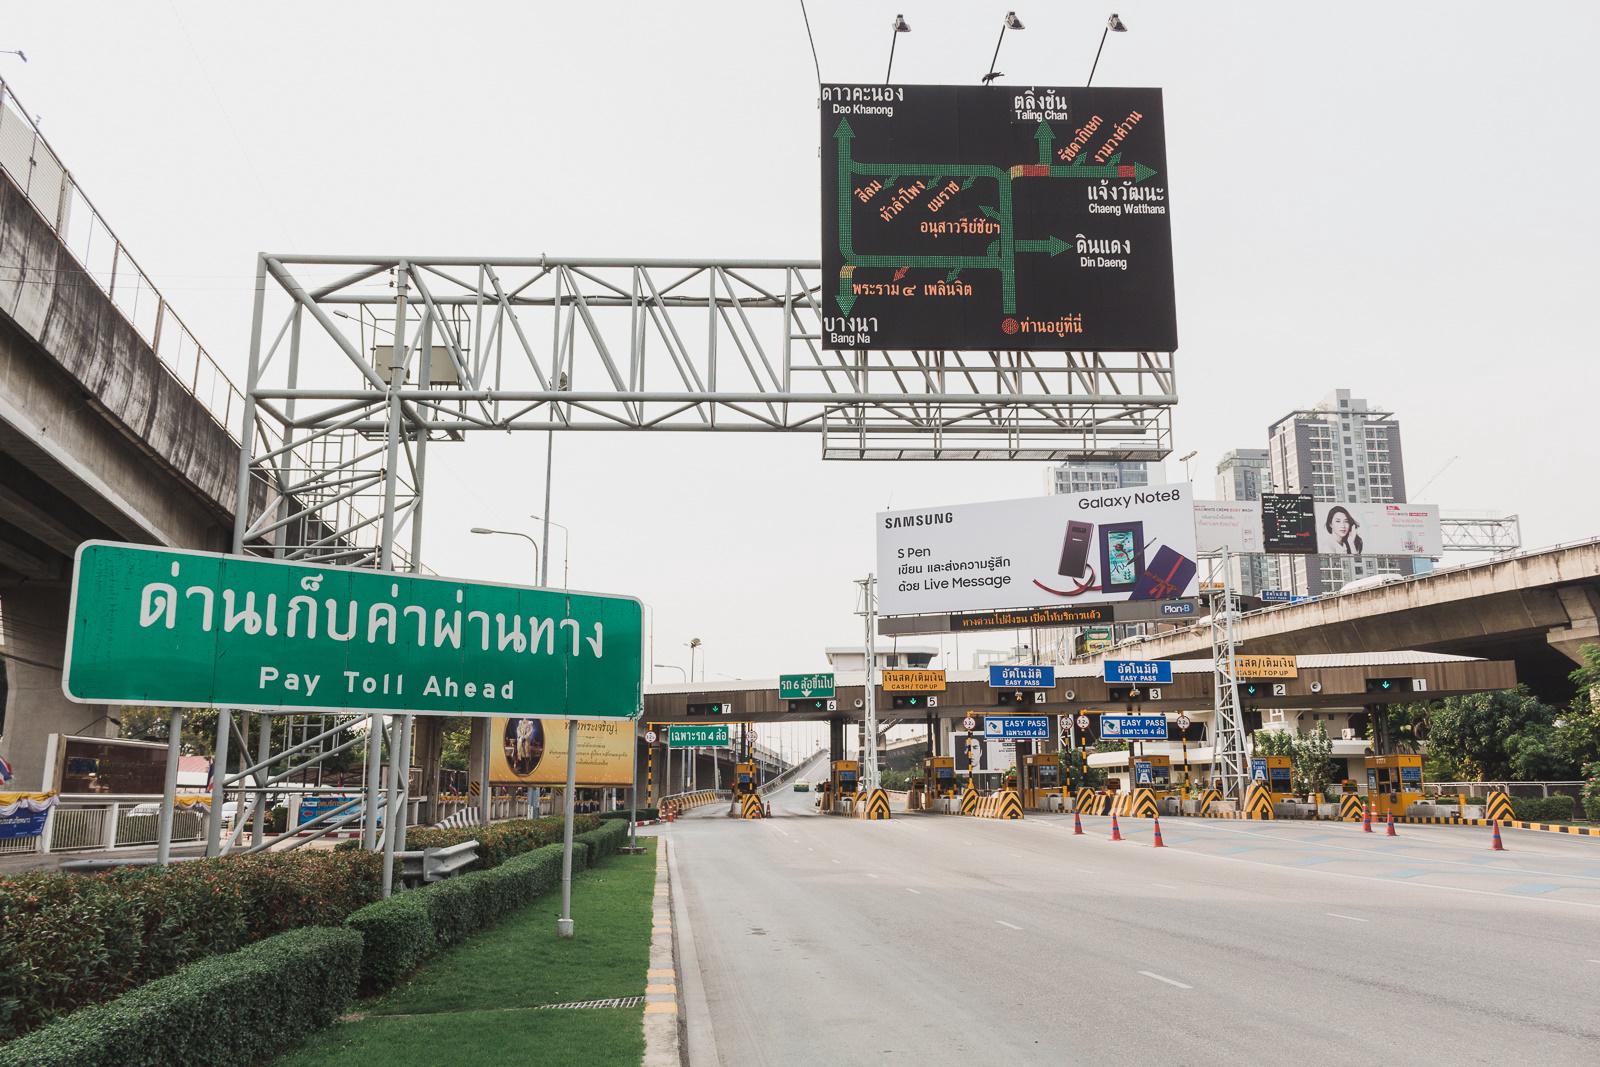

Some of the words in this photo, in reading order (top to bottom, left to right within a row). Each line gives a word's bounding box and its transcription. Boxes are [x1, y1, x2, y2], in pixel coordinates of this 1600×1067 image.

[822, 87, 904, 102] ดาวคะนอง
[1014, 87, 1067, 110] ตลิ่งชัน
[832, 104, 850, 114] Dao
[853, 104, 894, 117] Khanong
[1015, 110, 1043, 122] Taling
[1044, 110, 1068, 120] Chan
[1094, 110, 1143, 164] งามวงศ์วาน
[854, 179, 882, 203] สีลม
[927, 180, 960, 213] ยมราช
[1088, 179, 1164, 201] แจ้งวัฒนะ
[880, 180, 926, 222] หัวลำโพง
[1088, 204, 1122, 216] Chaeng
[1124, 204, 1166, 214] Watthana
[920, 217, 1000, 238] อนุสาวรีย์ชัยฯ
[1076, 233, 1131, 254] ดินแดง
[1080, 256, 1096, 268] Din
[1097, 257, 1128, 270] Daeng
[852, 282, 900, 296] พระราม
[924, 280, 972, 296] เพลินจิต
[824, 316, 878, 332] บางนา
[1020, 312, 1083, 338] ท่านอยู่ที่นี่
[830, 333, 854, 346] Bang
[857, 333, 870, 344] Na
[1078, 496, 1132, 510] Galaxy
[1134, 489, 1180, 504] Note8
[885, 512, 953, 529] SAMSUNG
[898, 548, 904, 558] S
[908, 548, 930, 558] Pen
[898, 564, 922, 575] เขียน
[927, 556, 1011, 572] และส่งความรู้สึก
[898, 580, 920, 592] ด้วย
[924, 578, 949, 590] Live
[952, 575, 1012, 588] Message
[139, 560, 604, 659] ด่านเก็บค่าผ่านทาง
[259, 666, 320, 697] Pay
[344, 670, 403, 695] Toll
[422, 675, 514, 700] Ahead
[794, 680, 799, 690] 6
[1276, 685, 1283, 694] 2
[1418, 680, 1422, 690] 1
[1036, 692, 1044, 702] 4
[1152, 690, 1159, 698] 3
[724, 704, 730, 713] 7
[829, 701, 835, 710] 6
[929, 698, 936, 706] 5
[708, 731, 714, 740] 4
